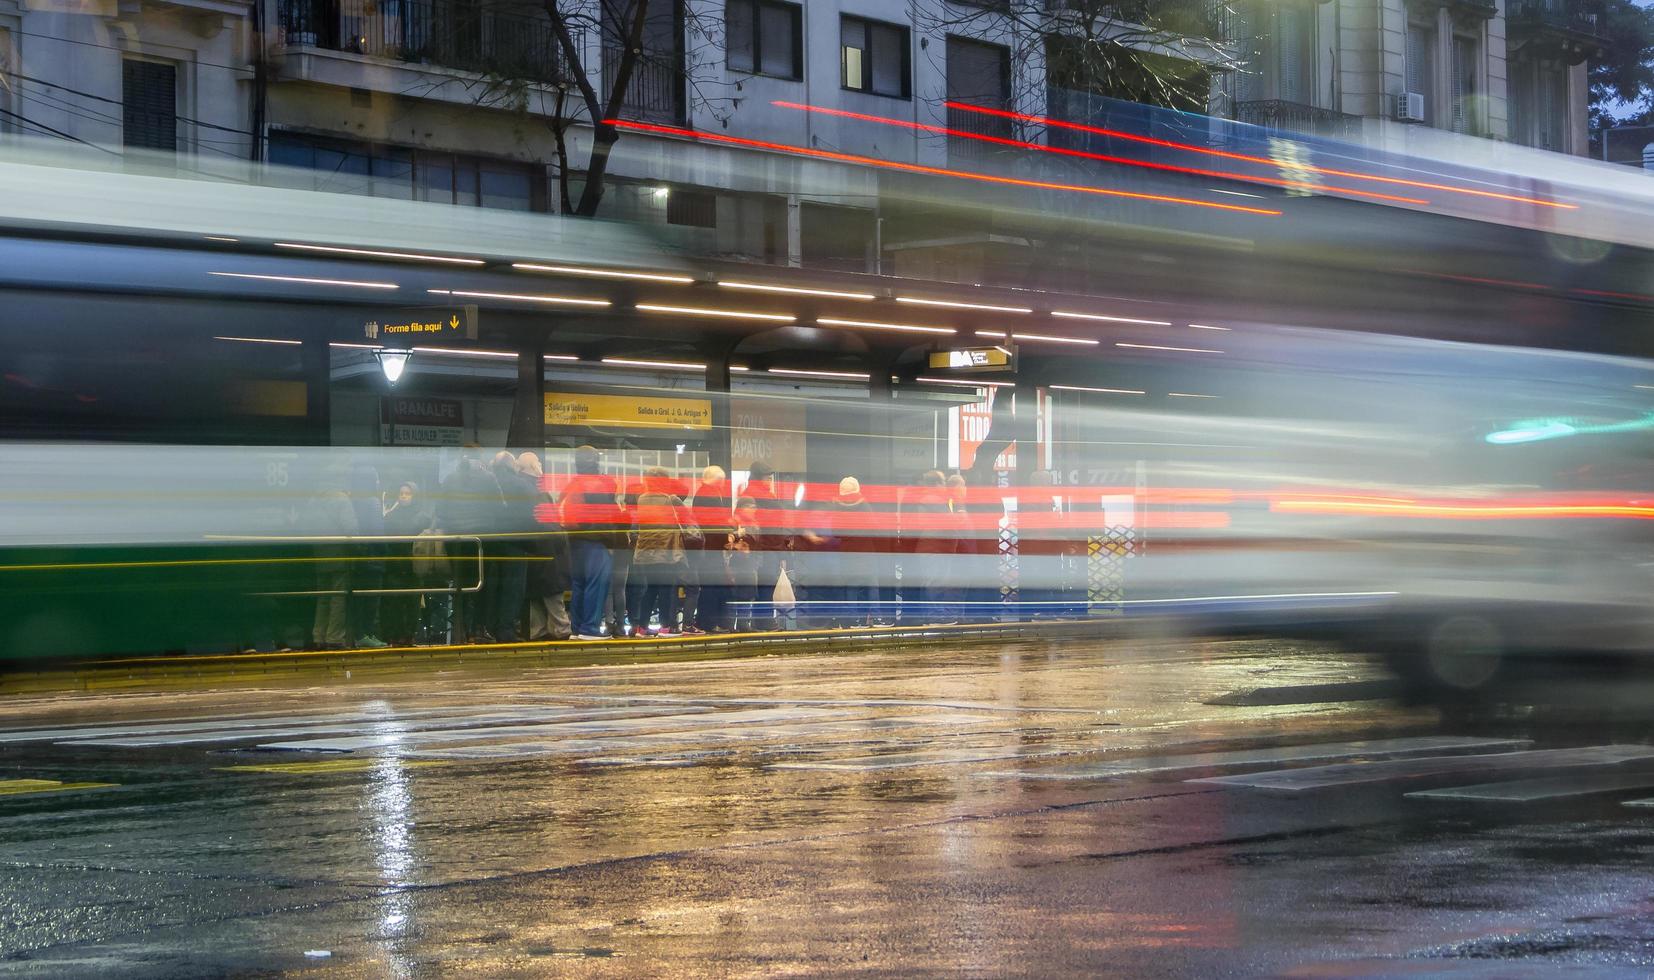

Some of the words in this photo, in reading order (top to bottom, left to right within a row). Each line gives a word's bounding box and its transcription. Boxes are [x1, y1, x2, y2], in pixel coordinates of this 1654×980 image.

[384, 324, 409, 333] Forme
[411, 322, 423, 332] fila
[951, 351, 972, 366] BA
[394, 401, 457, 418] RANALFE
[266, 462, 288, 487] 85
